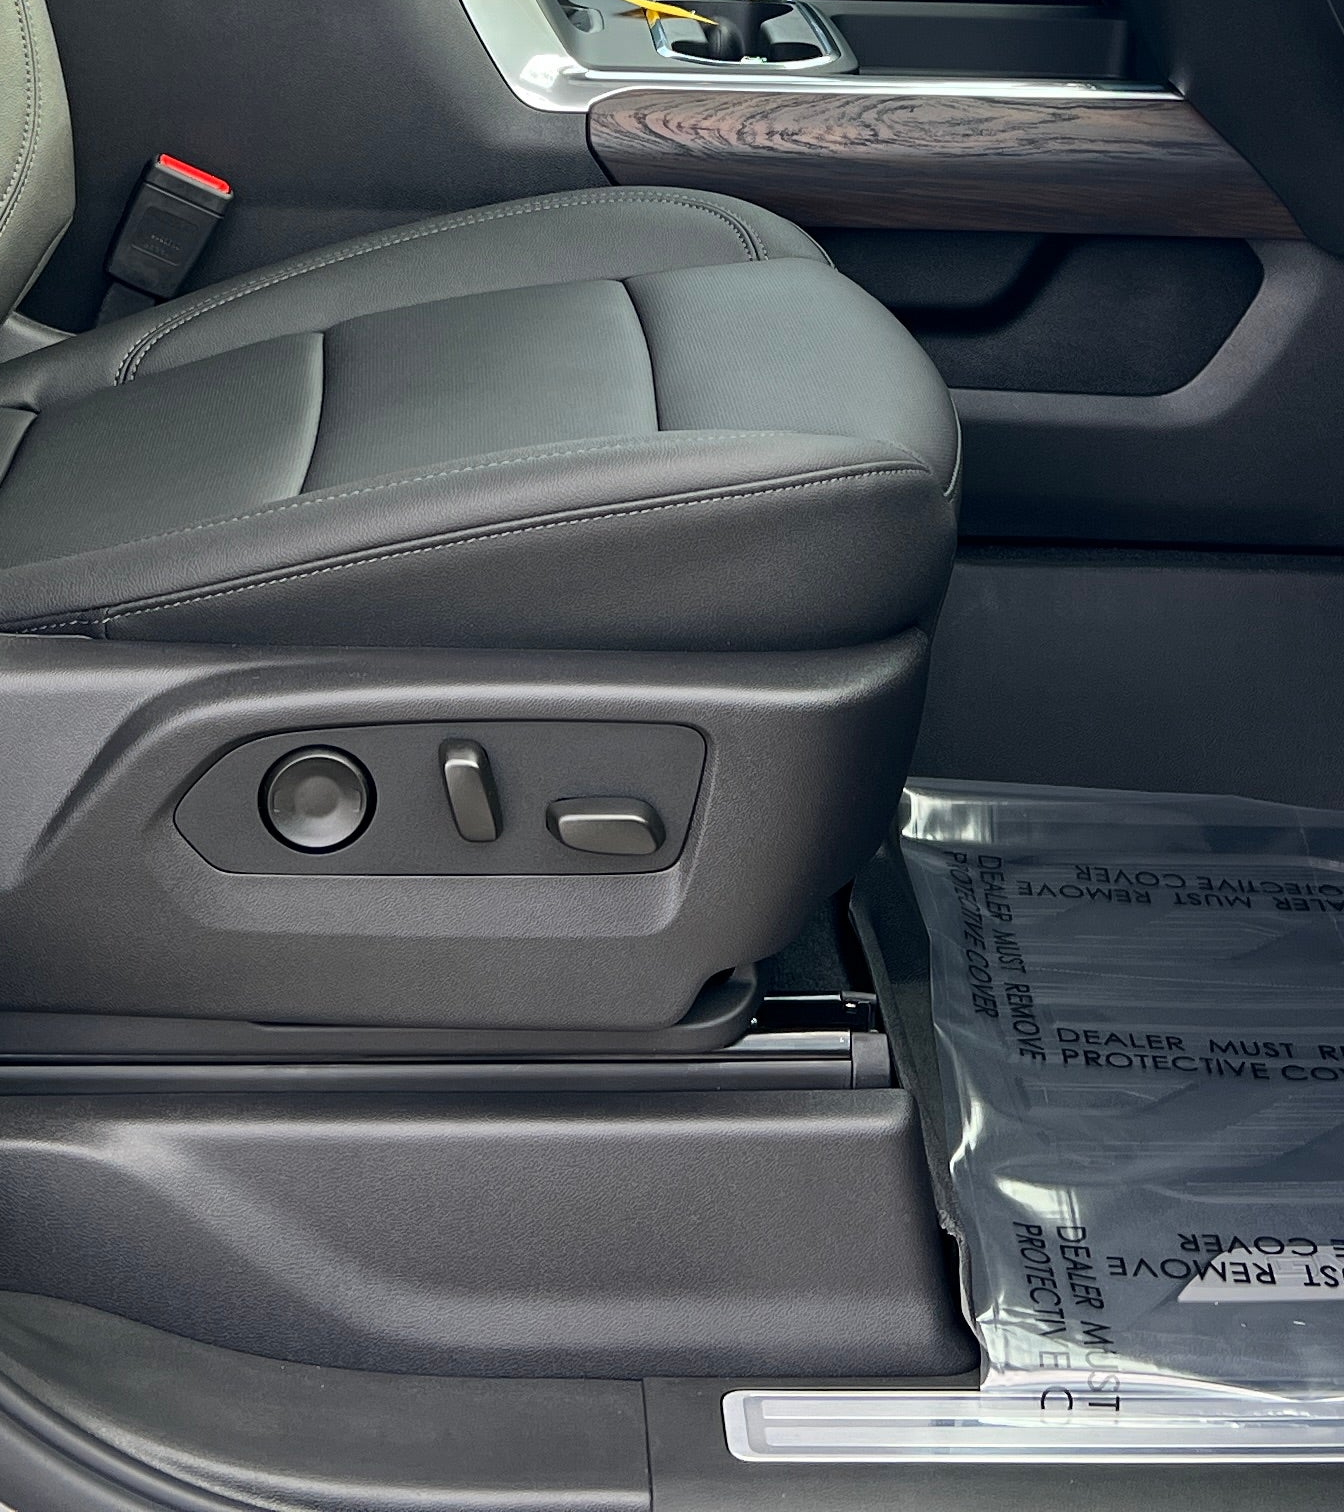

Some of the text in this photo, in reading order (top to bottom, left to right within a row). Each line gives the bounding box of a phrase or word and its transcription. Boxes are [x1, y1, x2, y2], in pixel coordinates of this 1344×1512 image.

[1075, 864, 1186, 888] COVER
[1016, 880, 1152, 905] REMOVE
[1173, 892, 1252, 909] MUST
[978, 855, 1046, 1062] DEALER MUST REMOVE
[965, 949, 999, 1019] COVER
[1057, 1027, 1185, 1051] DEALER
[1209, 1039, 1293, 1058] MUST
[1061, 1048, 1270, 1080] PROTECTIVE
[1178, 1232, 1318, 1257] COVER
[1108, 1255, 1276, 1286] REMOVE
[1012, 1221, 1072, 1370] PROTECTIVE
[1056, 1226, 1121, 1412] DEALER MUST
